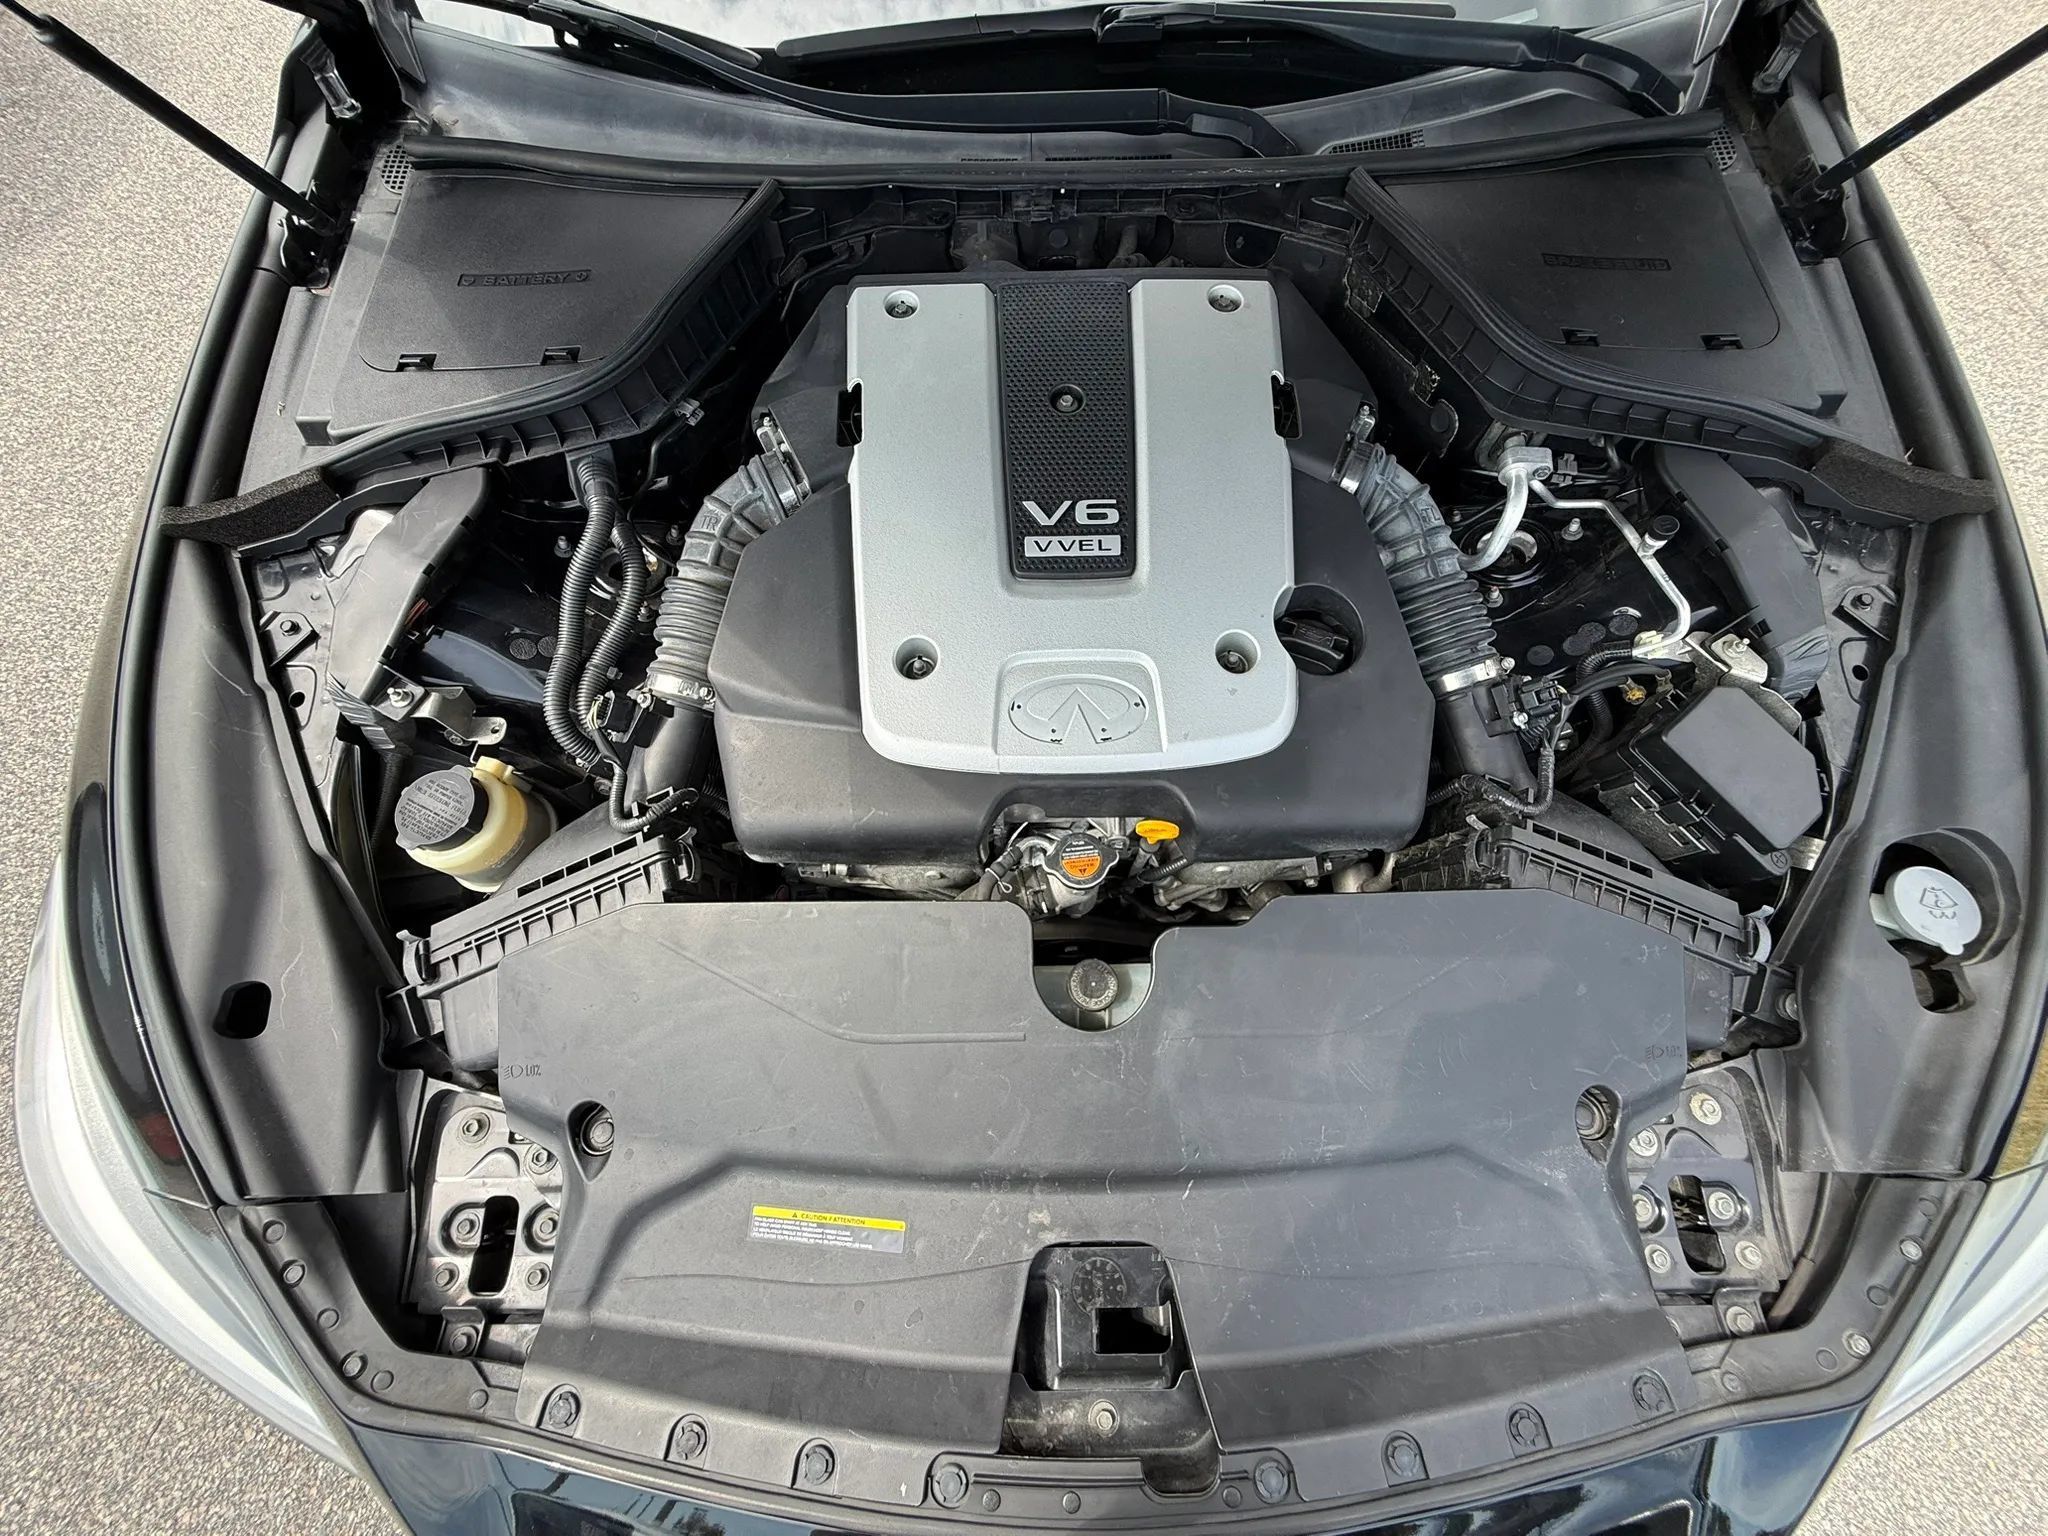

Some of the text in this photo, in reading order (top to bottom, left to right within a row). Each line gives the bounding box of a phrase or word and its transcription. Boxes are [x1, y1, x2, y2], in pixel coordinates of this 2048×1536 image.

[483, 272, 571, 286] BATTERY
[1021, 499, 1120, 526] V6
[1033, 539, 1112, 552] VVEL
[800, 1212, 827, 1222] CAUTION
[832, 1215, 866, 1226] ATTENTION
